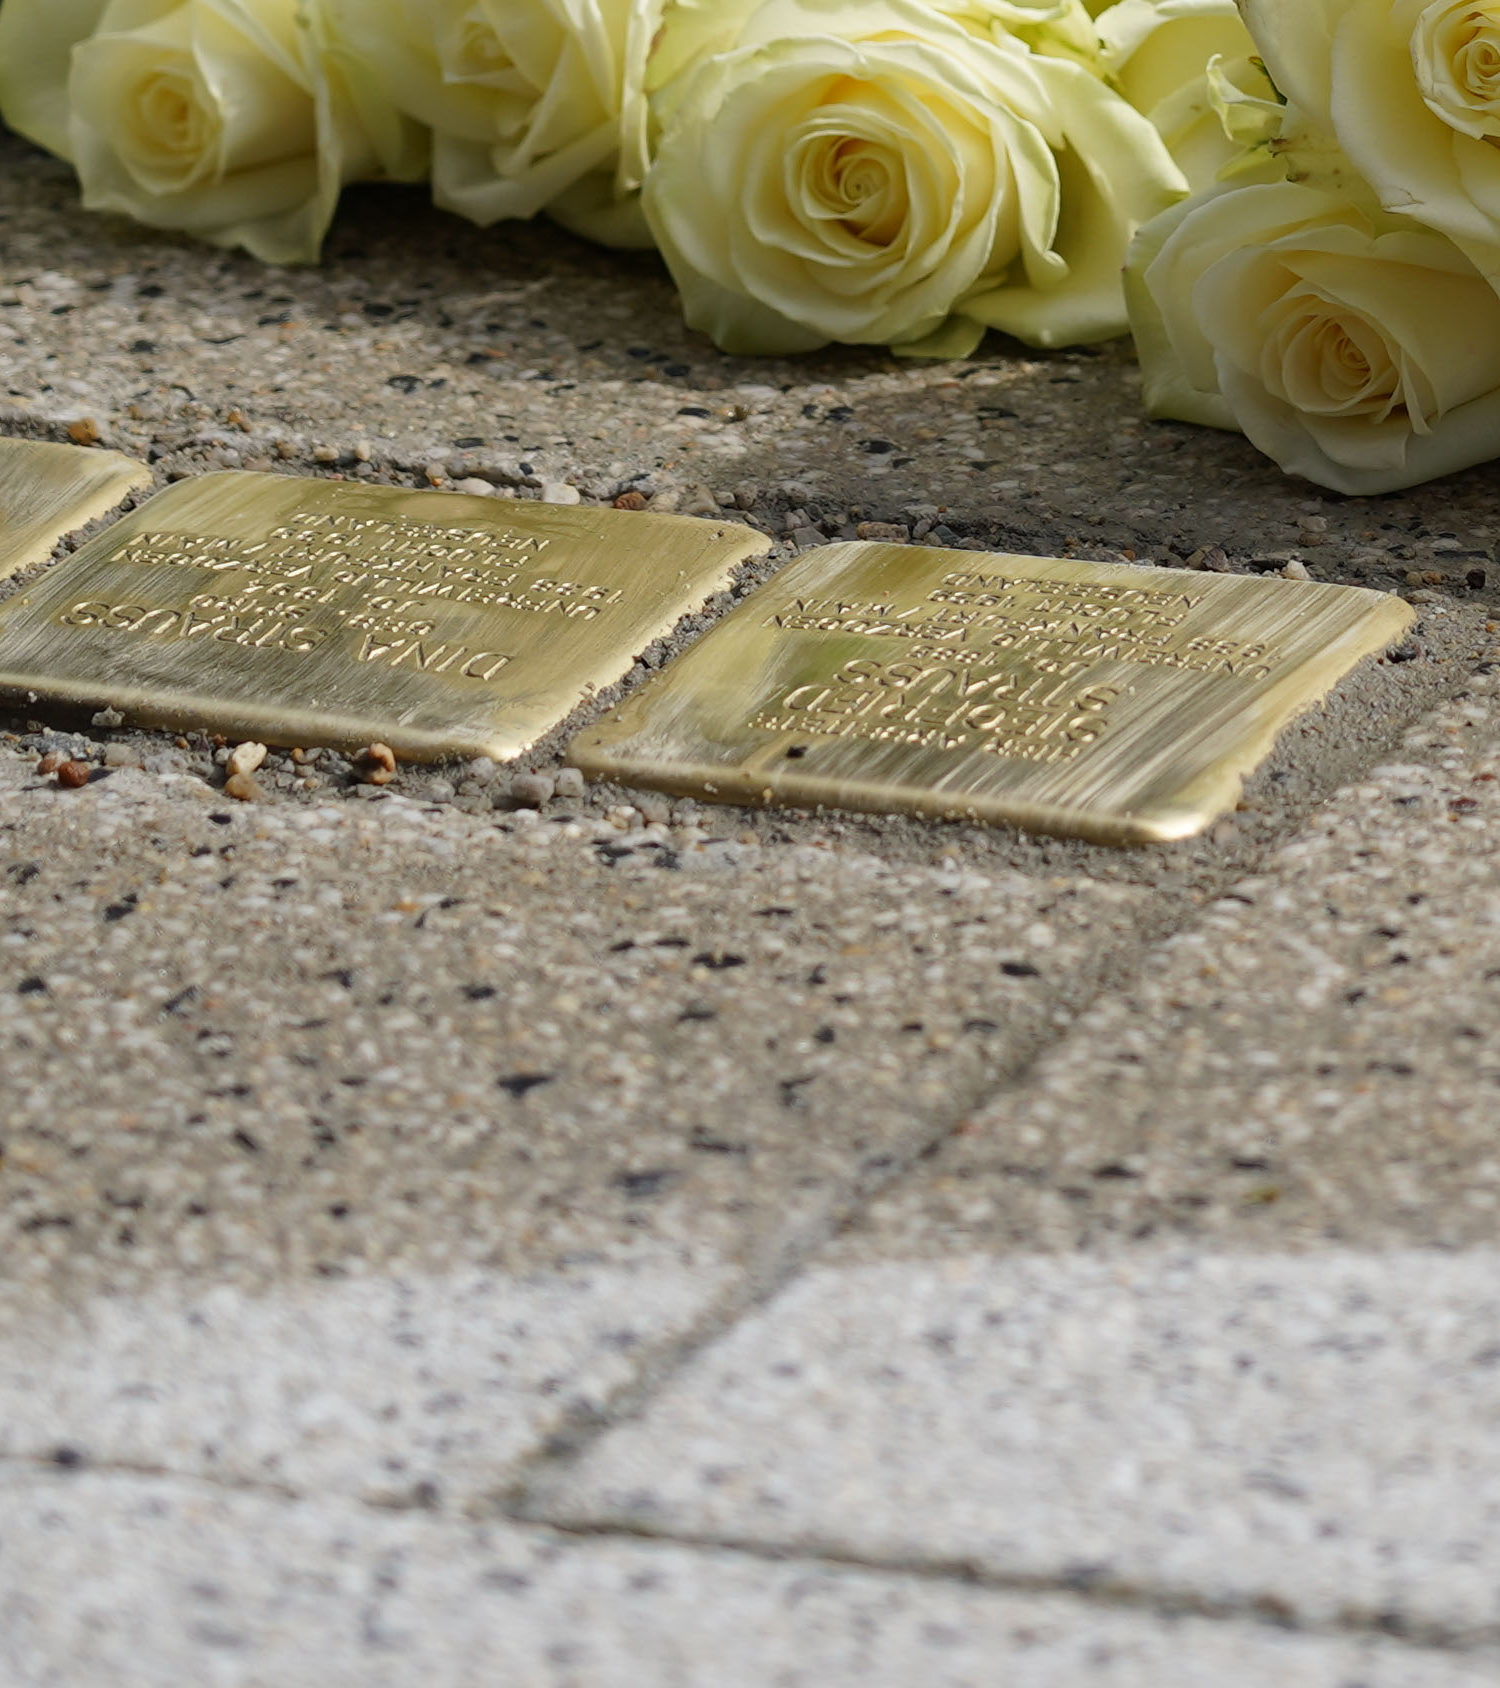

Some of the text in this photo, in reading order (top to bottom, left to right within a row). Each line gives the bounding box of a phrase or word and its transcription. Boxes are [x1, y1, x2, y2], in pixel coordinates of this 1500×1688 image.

[128, 532, 242, 551] MAIN
[266, 525, 532, 568] FLUCHT 1939
[292, 513, 549, 551] NEUSEELAND
[111, 549, 601, 619] UNFREIWILLIG VERZOGEN
[279, 546, 519, 585] FRANKFURT
[242, 579, 425, 612] JG. 1894
[529, 578, 625, 603] 1938
[783, 598, 896, 617] MAIN
[926, 589, 1186, 627] FLUCHT 1939
[942, 573, 1203, 608] NEUSEELAND
[189, 593, 437, 636] GEB. SPIRO
[933, 609, 1173, 646] FRANKFURT
[66, 602, 514, 680] DINA STRAUSS
[763, 615, 1270, 678] UNFREIWILLIG VERZOGEN
[1186, 637, 1278, 659] 1938
[839, 659, 1118, 710] STRAUSS
[1020, 658, 1087, 677] JG.
[777, 684, 1107, 742] SIEGFRIED
[748, 713, 1079, 762] HIER ARBEITETE
